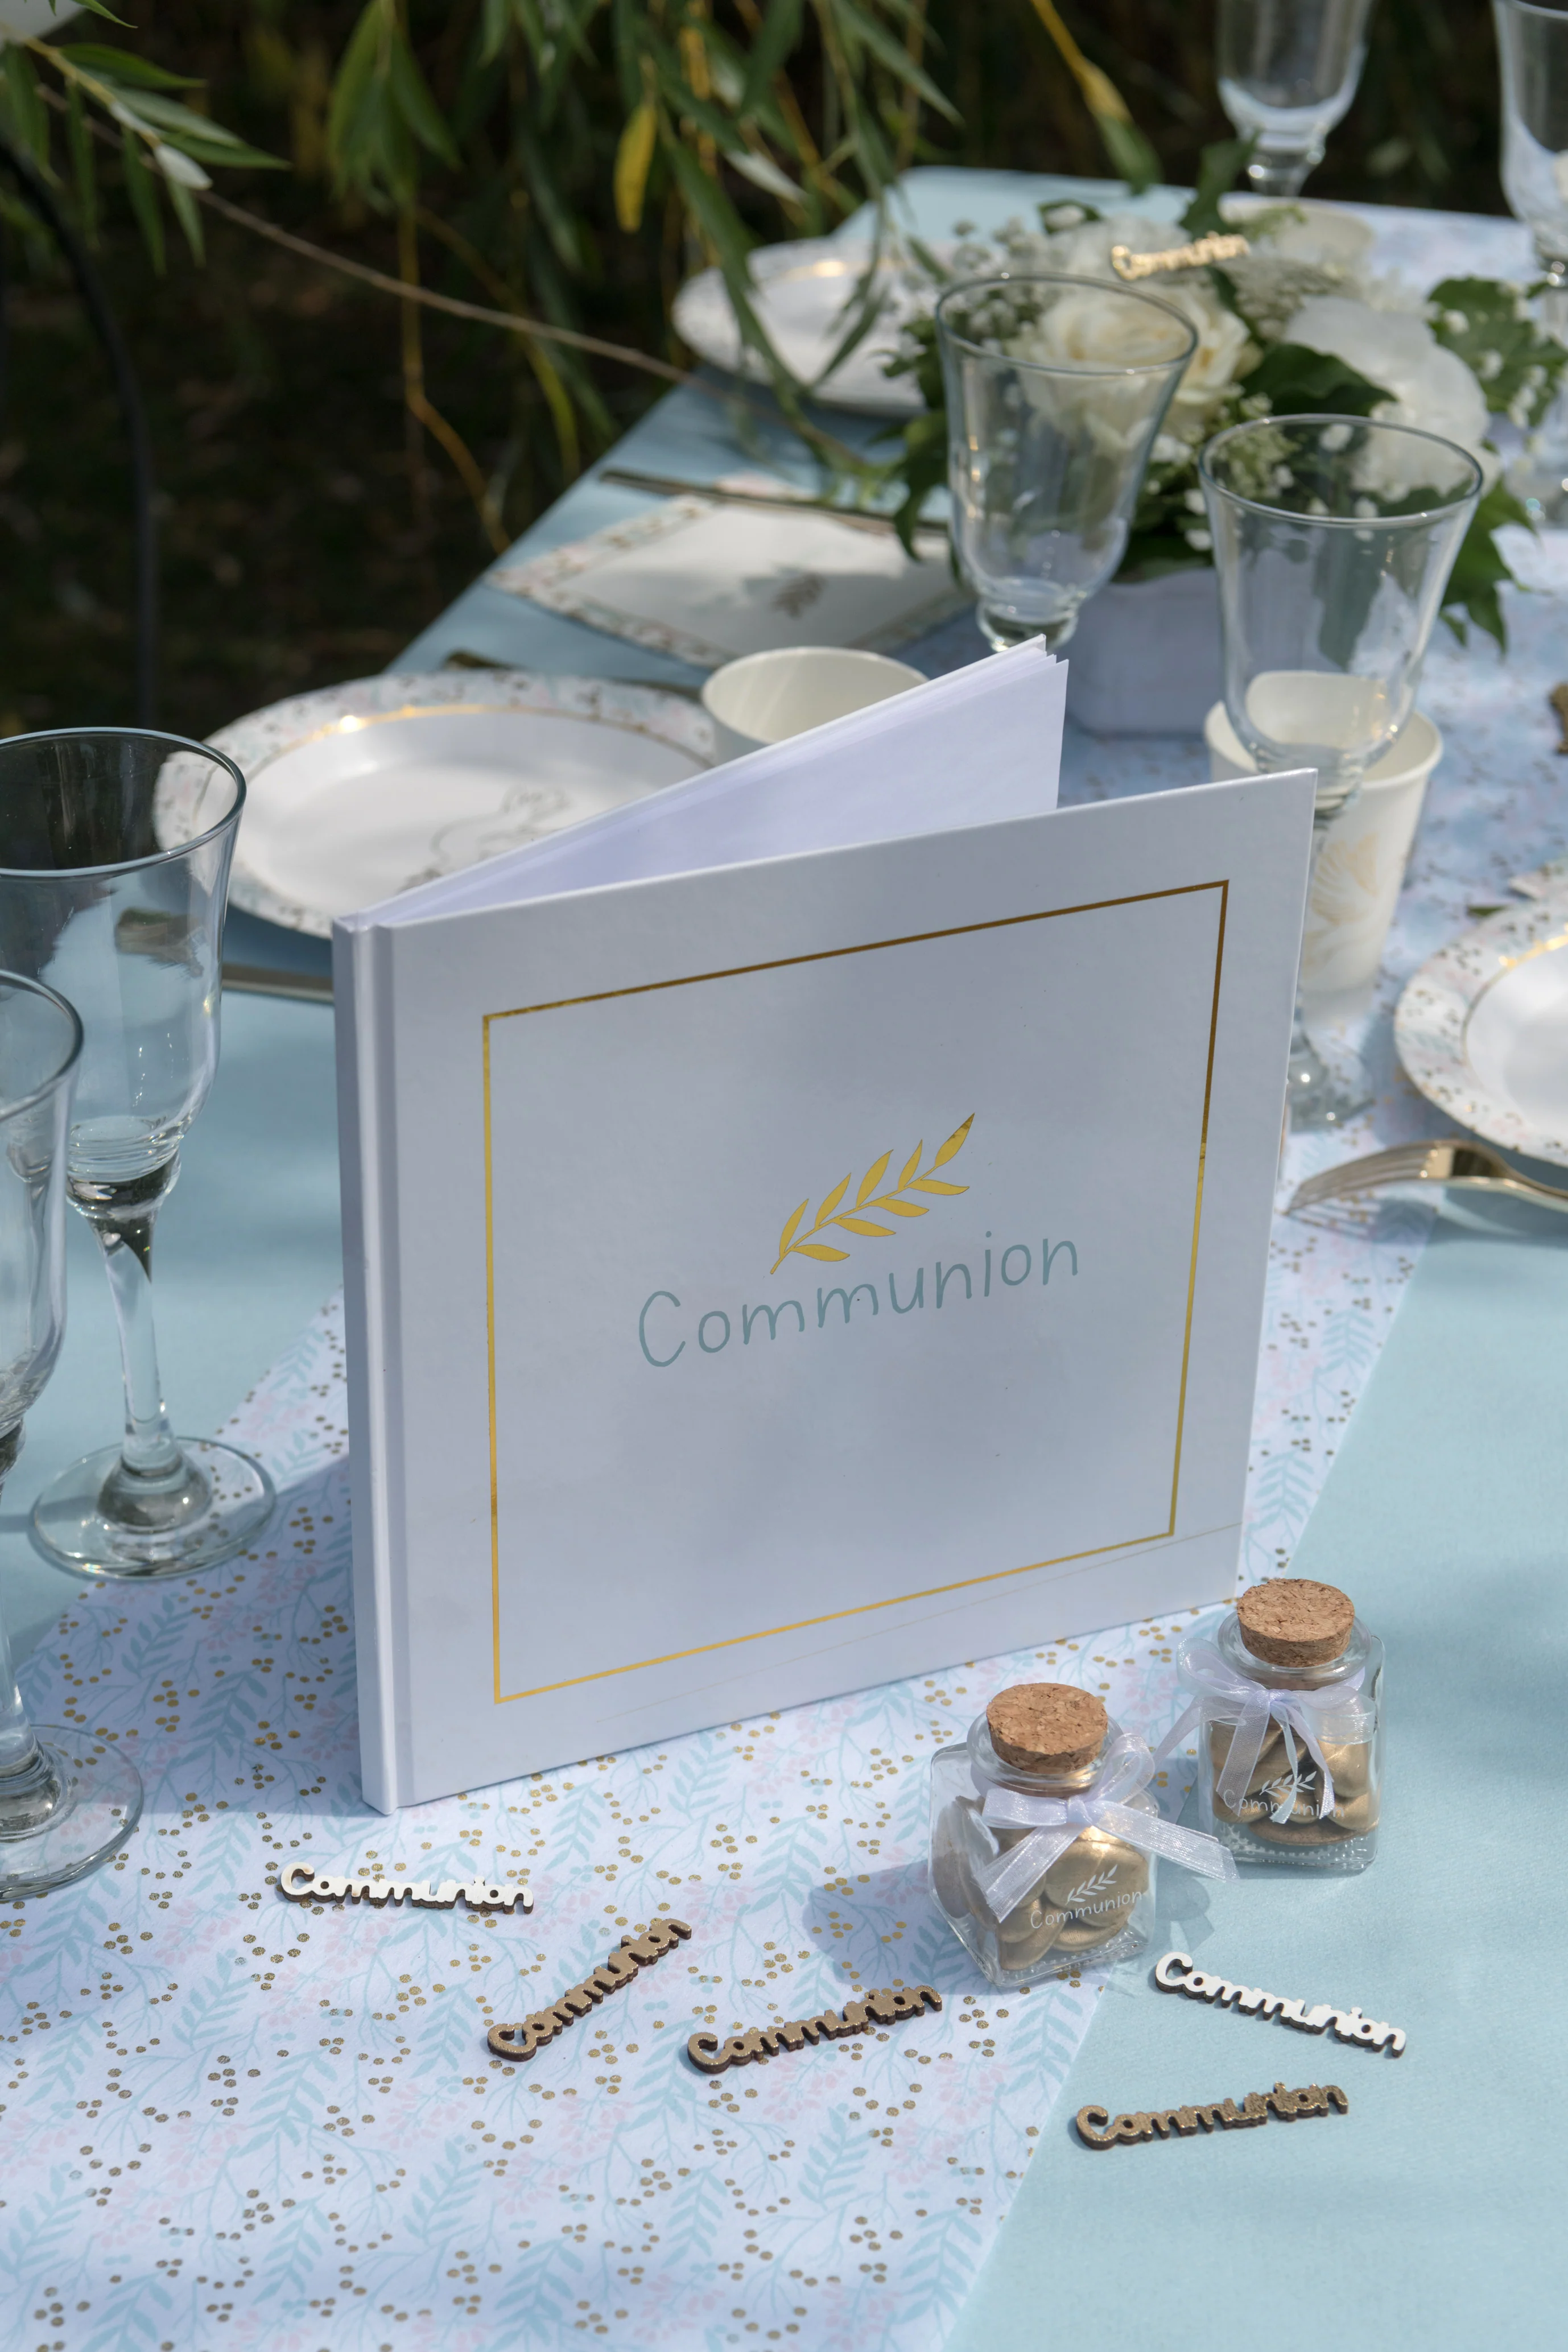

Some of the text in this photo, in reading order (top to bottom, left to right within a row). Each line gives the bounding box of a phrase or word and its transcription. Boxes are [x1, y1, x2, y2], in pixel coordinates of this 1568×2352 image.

[638, 1231, 1079, 1367] Communion
[281, 1862, 534, 1914] Communion
[1030, 1891, 1142, 1929] Communion
[488, 1918, 692, 2062] Communion
[688, 1984, 942, 2074] Communion
[1155, 1951, 1406, 2058] Communion
[1076, 2081, 1348, 2151] Communion
